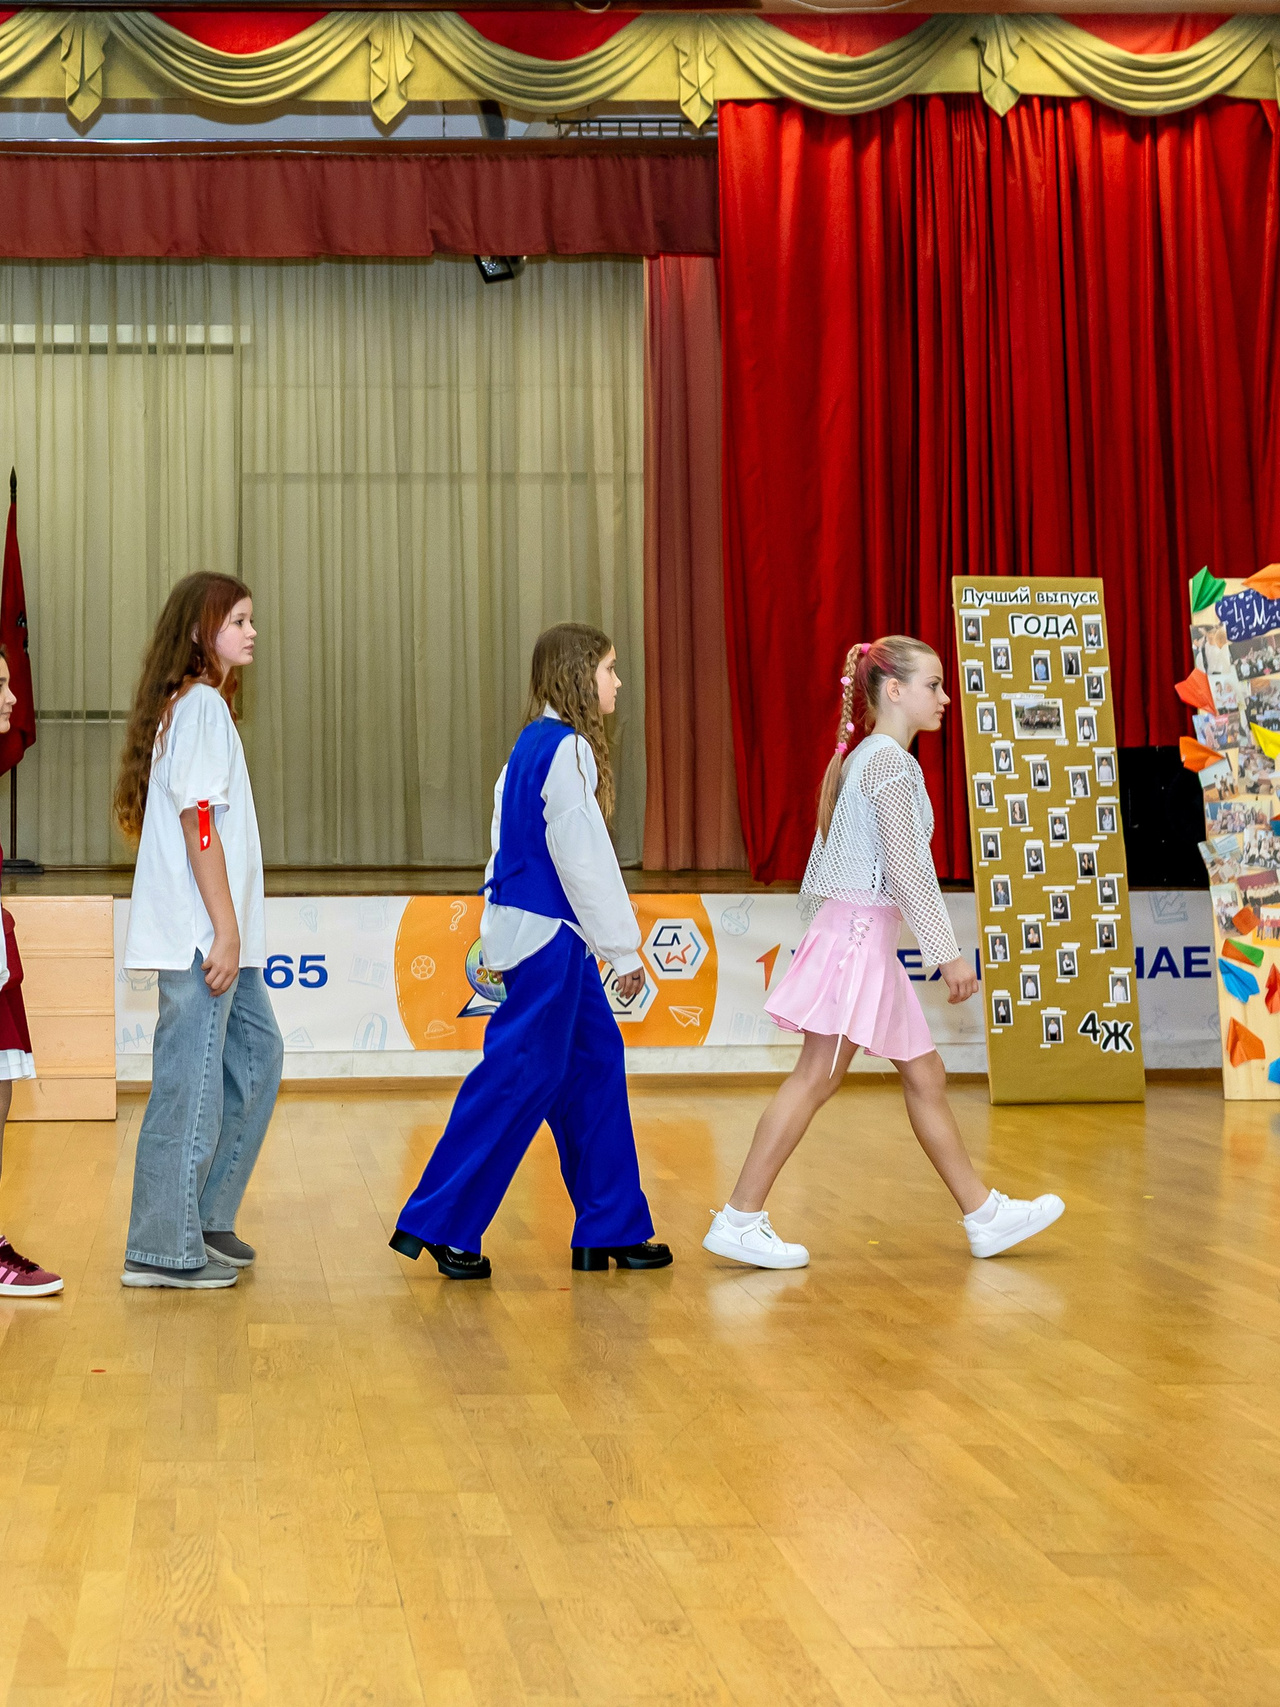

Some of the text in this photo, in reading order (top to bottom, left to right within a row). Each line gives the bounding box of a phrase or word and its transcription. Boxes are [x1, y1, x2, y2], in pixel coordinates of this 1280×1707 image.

[963, 587, 1097, 608] Лучший выпуск
[1010, 615, 1077, 638] ГОДА
[1079, 1012, 1133, 1051] 4Ж
